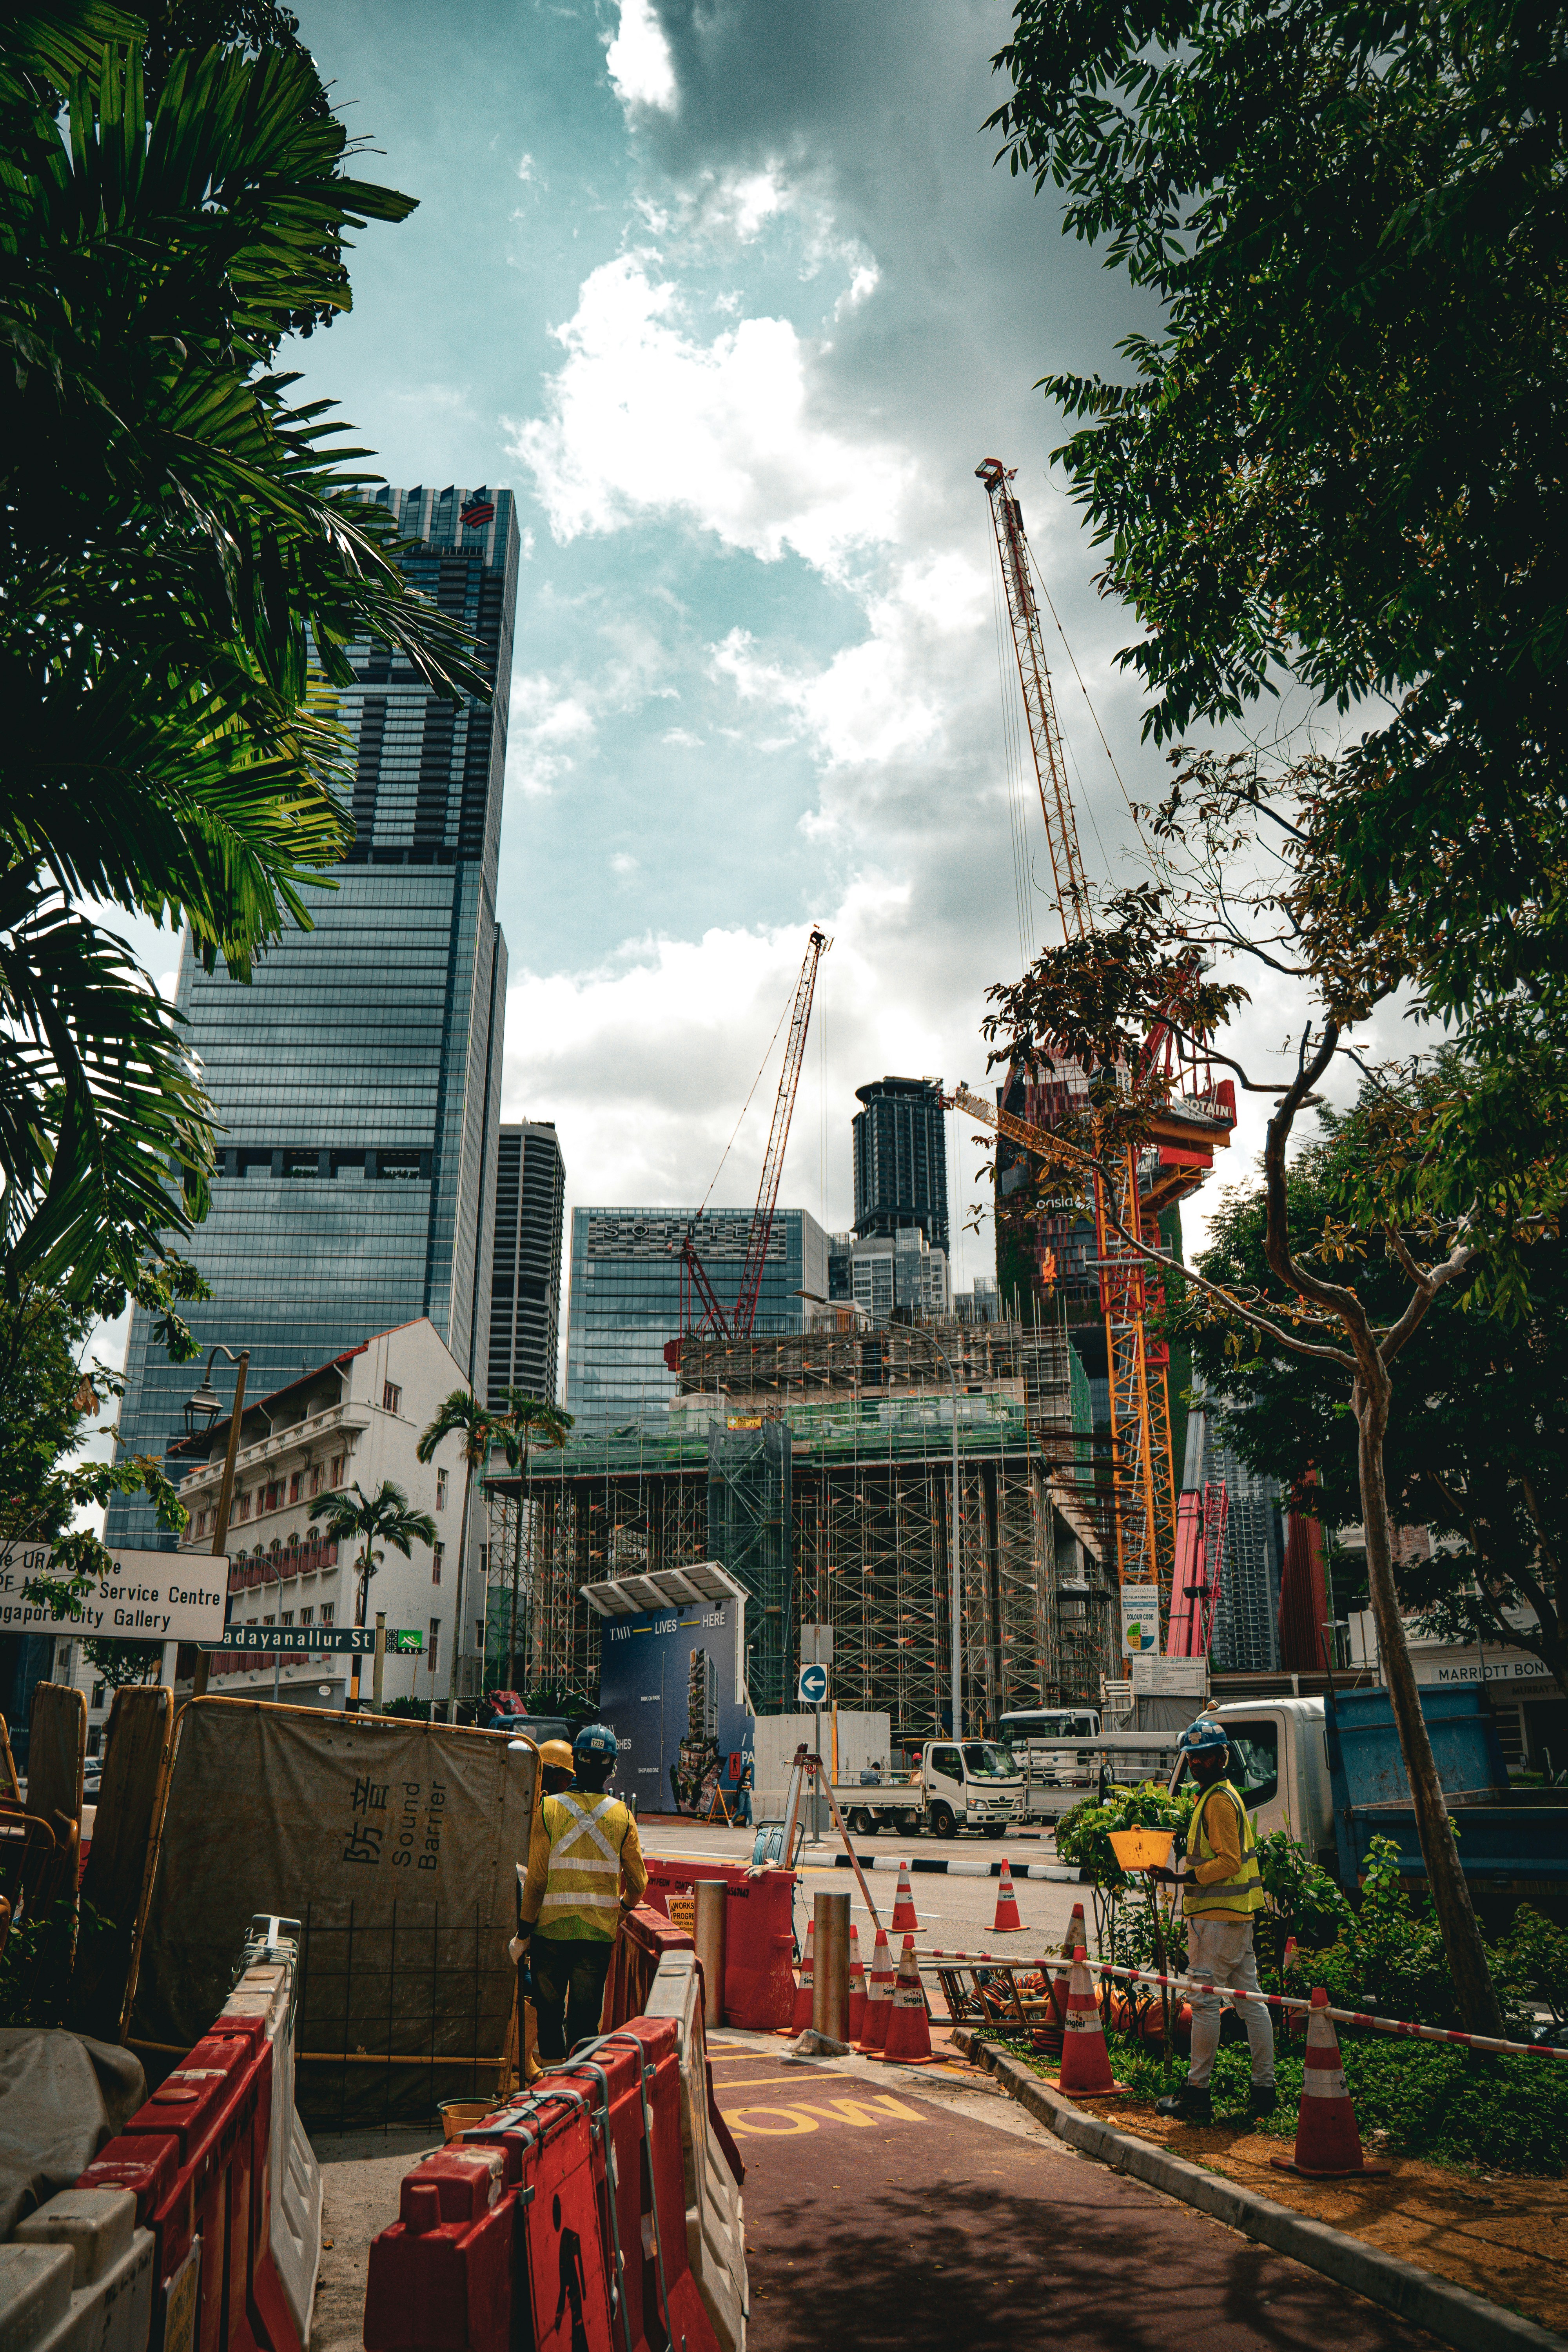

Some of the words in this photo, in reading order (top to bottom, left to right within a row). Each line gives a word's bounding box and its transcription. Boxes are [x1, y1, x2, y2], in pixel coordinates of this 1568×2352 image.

[1036, 1196, 1073, 1209] oasia
[604, 1224, 776, 1238] SOFITEL
[100, 1582, 159, 1602] Service
[169, 1587, 220, 1606] Centre
[0, 1606, 60, 1625] gapore
[114, 1609, 171, 1633] Gallery
[610, 1626, 632, 1641] TMW
[655, 1619, 677, 1635] LIVES
[702, 1612, 725, 1628] HERE
[224, 1629, 342, 1649] adayanallur
[352, 1632, 370, 1647] St
[1439, 1666, 1508, 1681] MARRIOTT
[1514, 1662, 1544, 1676] BON
[1512, 1686, 1549, 1695] MURRAY
[343, 1776, 389, 1864] 防音
[392, 1782, 421, 1867] Sound
[417, 1780, 446, 1870] Barrier
[720, 2094, 928, 2135] OW
